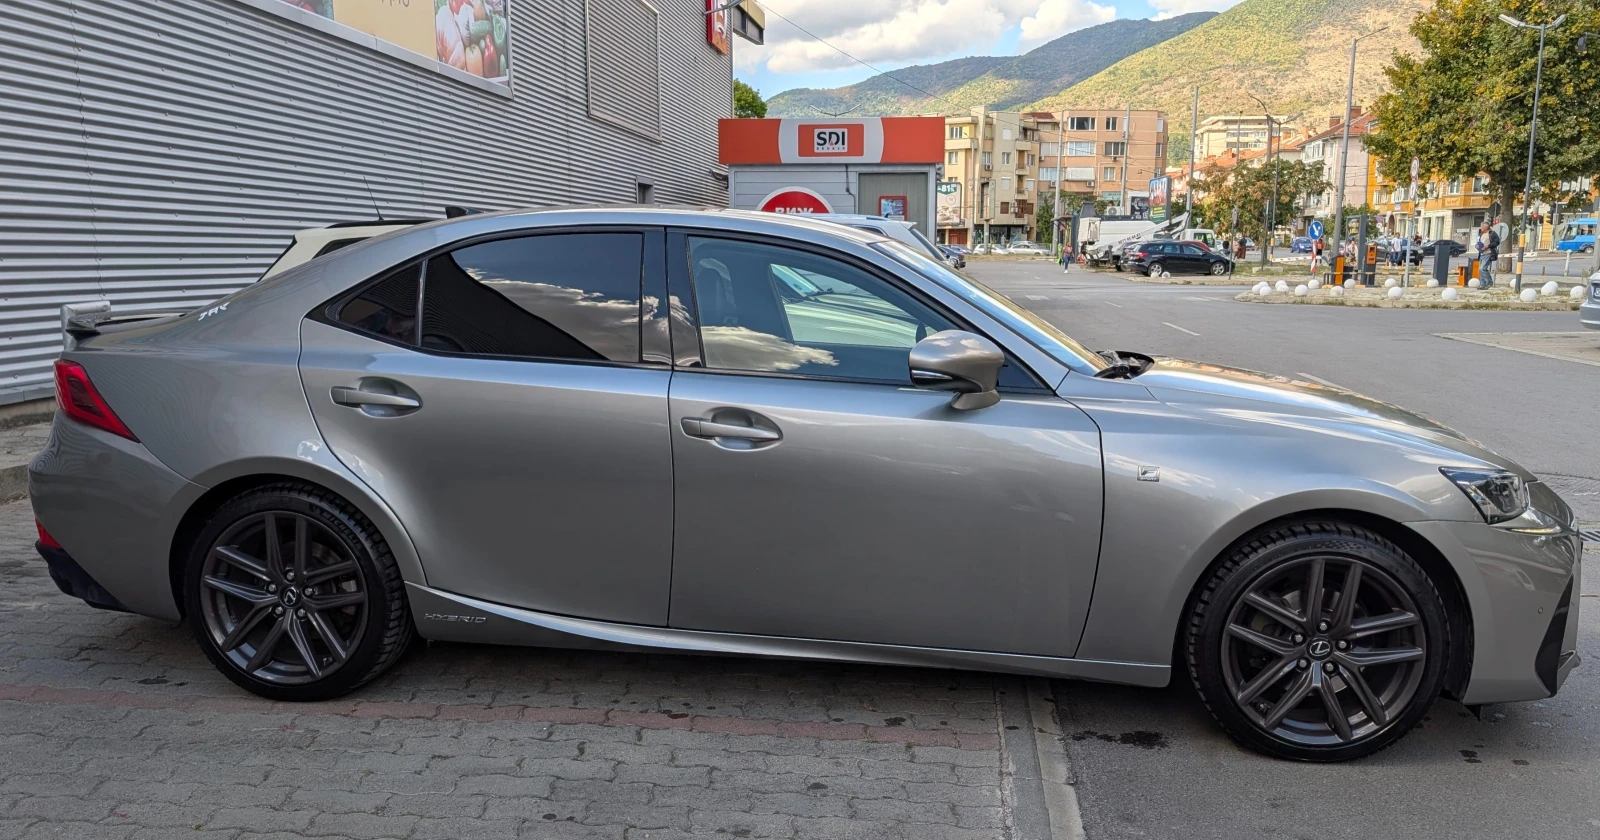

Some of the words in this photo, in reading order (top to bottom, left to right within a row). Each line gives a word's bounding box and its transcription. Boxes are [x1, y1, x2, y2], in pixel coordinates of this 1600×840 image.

[816, 131, 845, 146] SDI
[321, 511, 364, 550] MICHELIN
[423, 613, 487, 624] HYBRID
